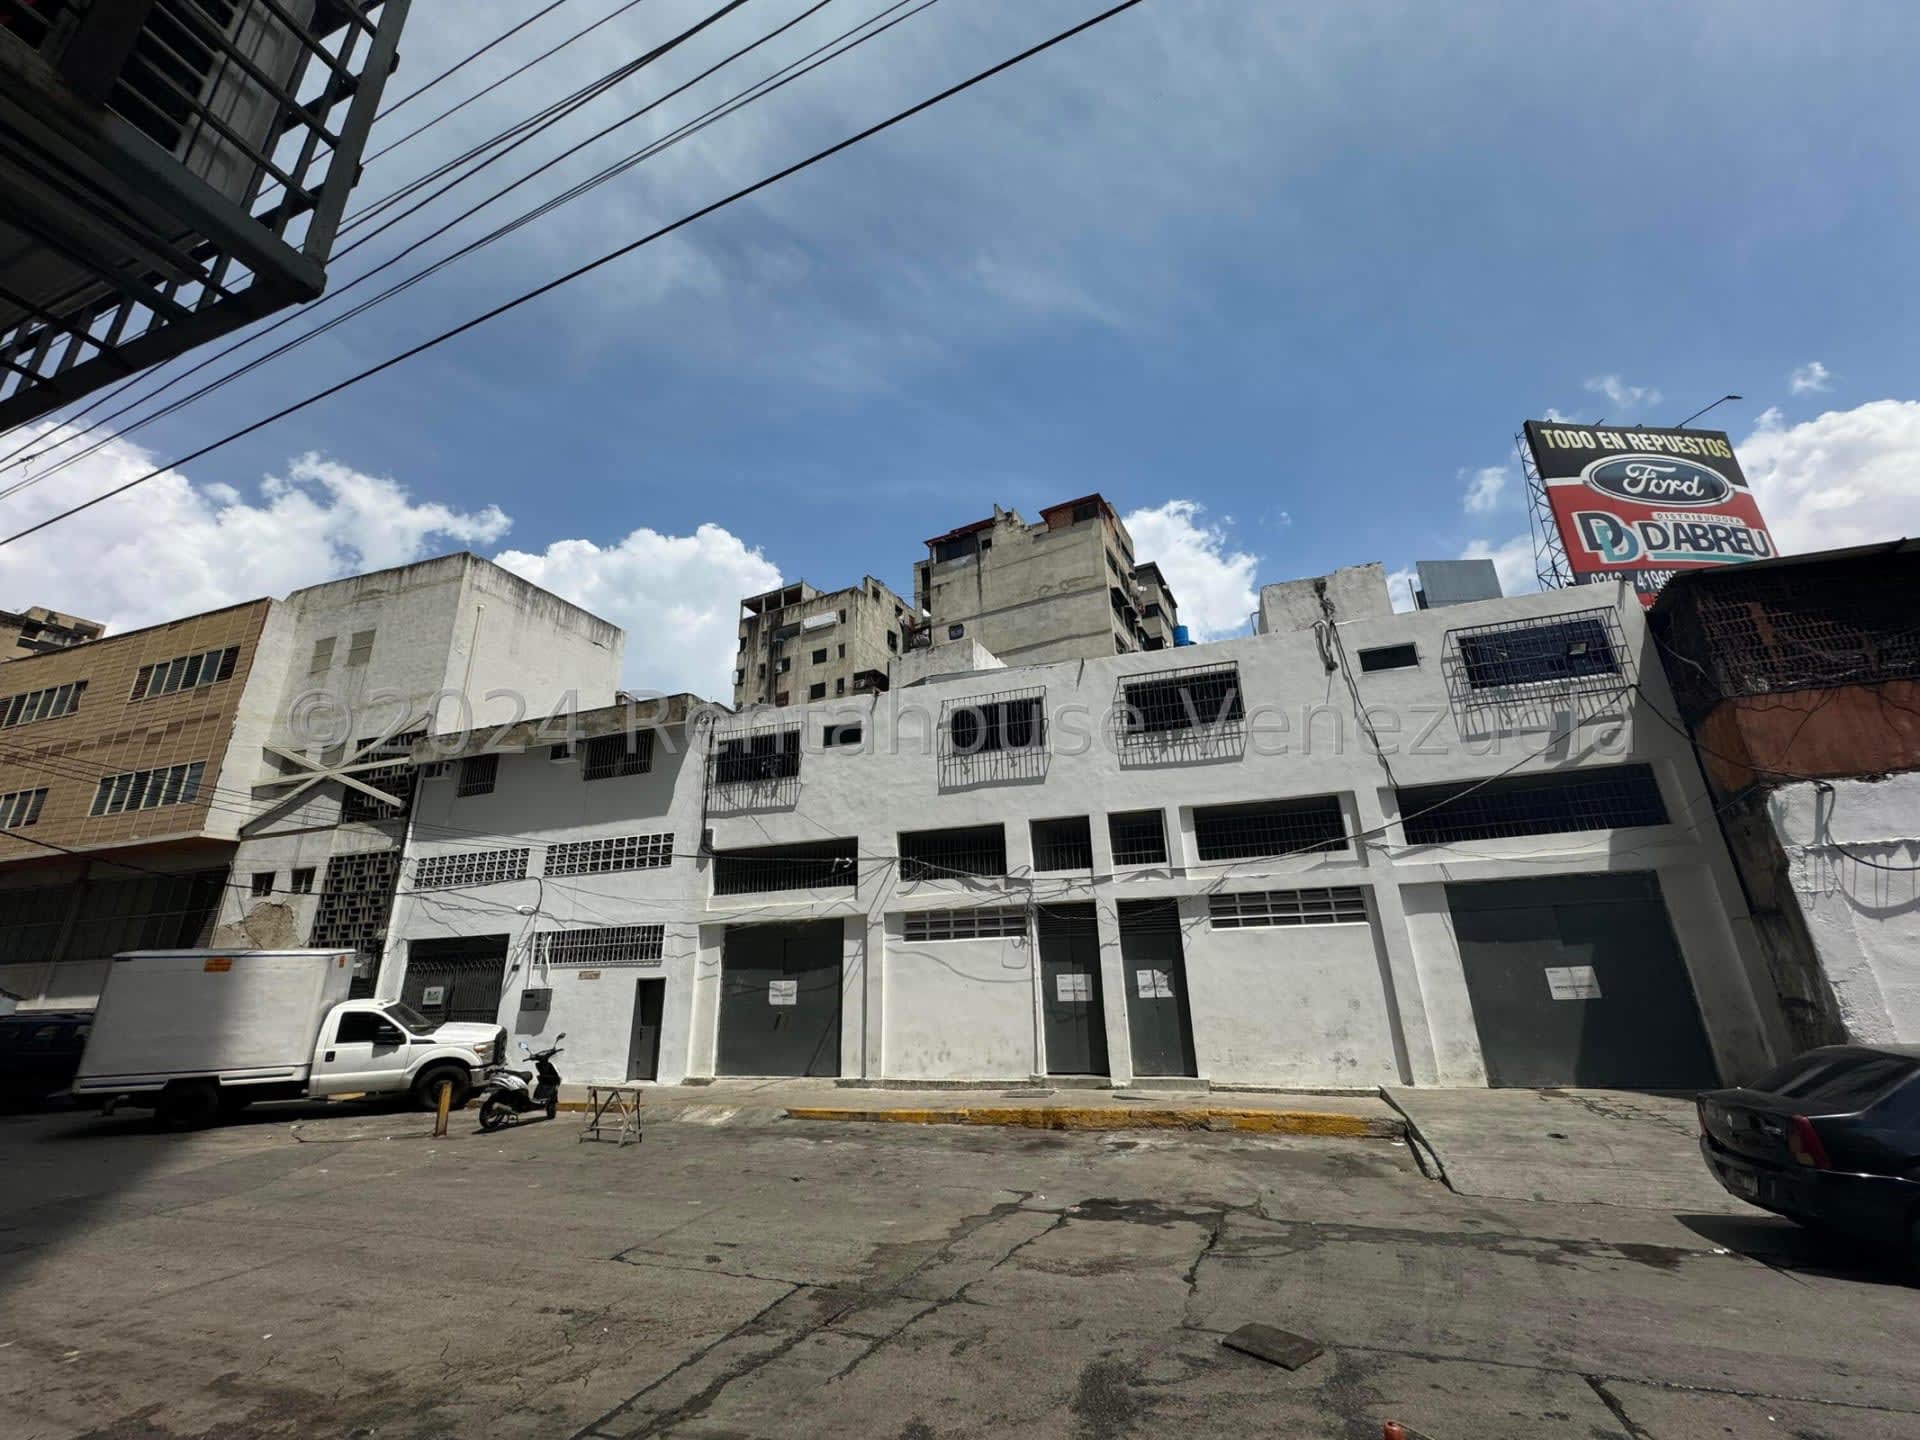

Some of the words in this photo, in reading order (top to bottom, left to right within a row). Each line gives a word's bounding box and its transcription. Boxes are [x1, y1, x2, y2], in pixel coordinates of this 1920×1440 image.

[1541, 429, 1596, 449] TODO
[1598, 431, 1627, 450] EN
[1626, 432, 1732, 459] REPUESTOS
[1622, 463, 1705, 497] Ford
[1656, 512, 1742, 526] DISTRIBUIDORA
[1638, 521, 1771, 558] D'ABREU
